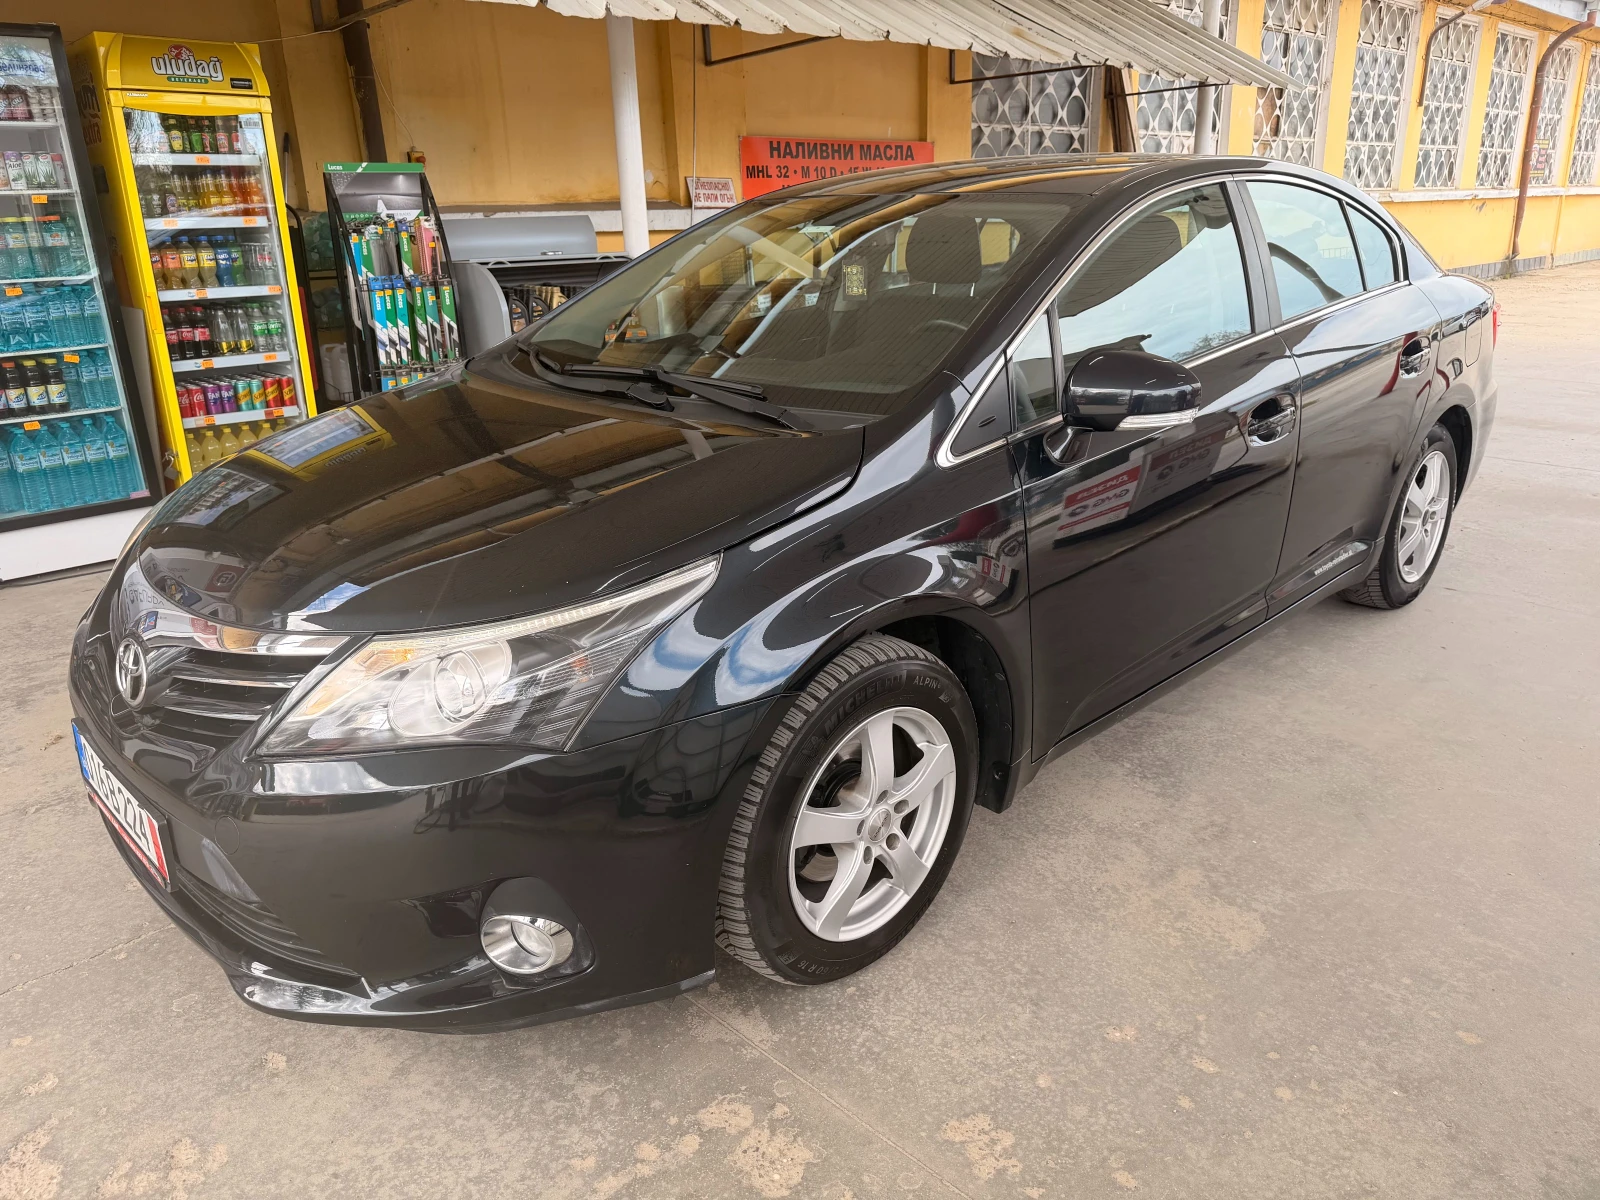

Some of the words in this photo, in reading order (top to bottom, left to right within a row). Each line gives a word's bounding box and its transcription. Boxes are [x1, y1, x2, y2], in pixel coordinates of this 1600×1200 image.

[151, 54, 224, 82] uludağ
[769, 140, 855, 160] НАЛИВНИ
[859, 144, 915, 161] МАСЛА
[746, 165, 772, 179] MHL
[776, 165, 790, 178] 32
[801, 166, 811, 179] M
[813, 166, 827, 179] 10
[703, 193, 719, 203] ПАЛИ
